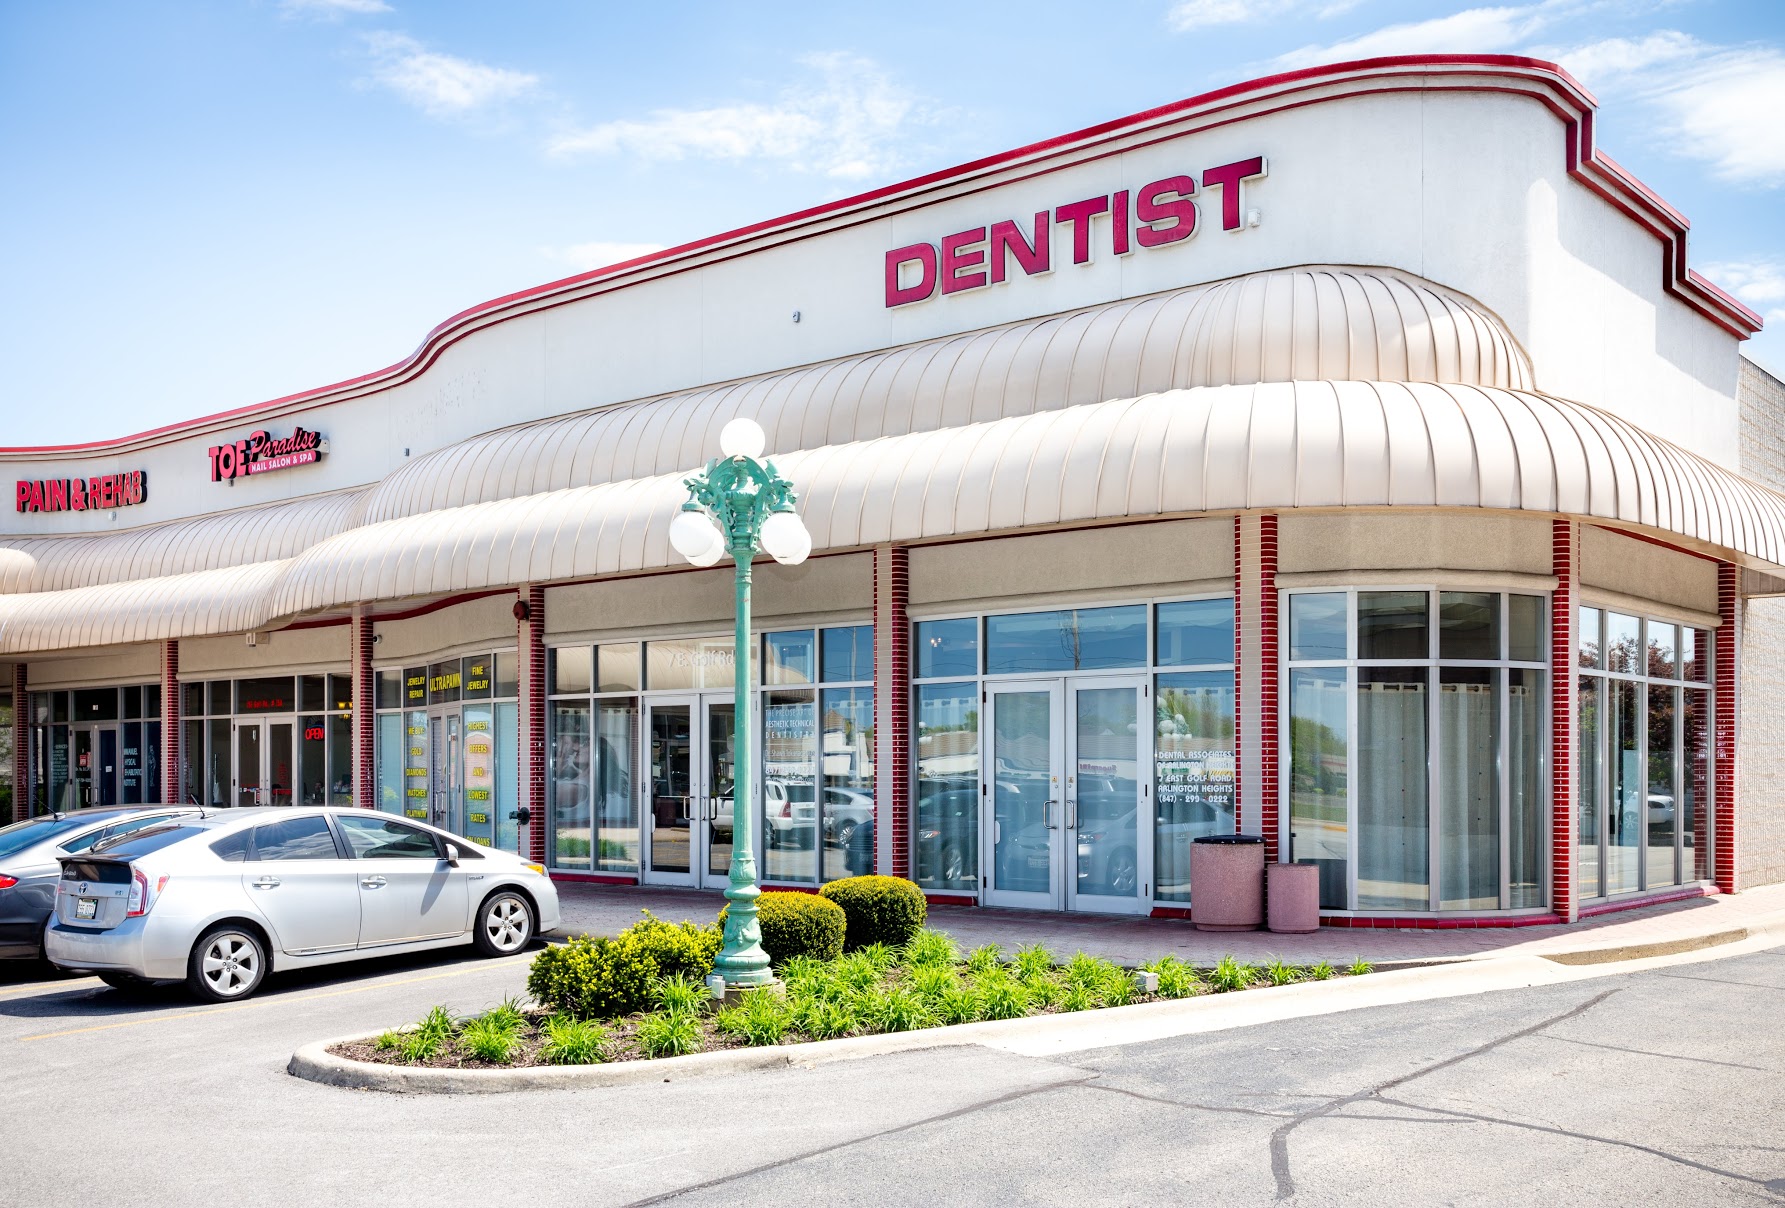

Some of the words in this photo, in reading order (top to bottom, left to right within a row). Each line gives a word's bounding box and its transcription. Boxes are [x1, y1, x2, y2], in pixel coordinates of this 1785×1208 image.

[886, 156, 1268, 309] DENTIST
[209, 439, 249, 482] TOE
[250, 427, 319, 461] Paradise
[251, 463, 267, 473] NAIL
[268, 457, 291, 469] SALON
[293, 455, 298, 464] &
[299, 452, 313, 463] SPA
[16, 479, 71, 512] PAIN
[71, 478, 88, 511] &
[89, 470, 147, 509] REHAB
[691, 650, 716, 667] Golf
[472, 665, 484, 676] FINE
[407, 676, 426, 687] JEWELRY
[466, 679, 489, 691] JEWELRY
[408, 689, 424, 699] REPAIR
[467, 721, 489, 731] HIGHEST
[765, 719, 789, 729] AESTHETIC
[790, 719, 815, 728] TECHNICAL
[305, 728, 325, 740] OPEN
[410, 747, 423, 757] GOLD
[469, 744, 488, 754] OFFERS
[1159, 751, 1186, 759] DENTAL
[1188, 750, 1232, 759] ASSOCIATES
[1166, 761, 1205, 769] ARLINGTON
[406, 768, 427, 778] DIAMONDS
[472, 767, 484, 777] AND
[1187, 774, 1208, 782] GOLF
[1158, 784, 1199, 793] ARLINGTON
[1201, 784, 1233, 793] HEIGHTS
[468, 790, 488, 801] LOWEST
[1159, 794, 1177, 804] (847)
[1208, 795, 1228, 803] 0222
[470, 813, 487, 823] RATES
